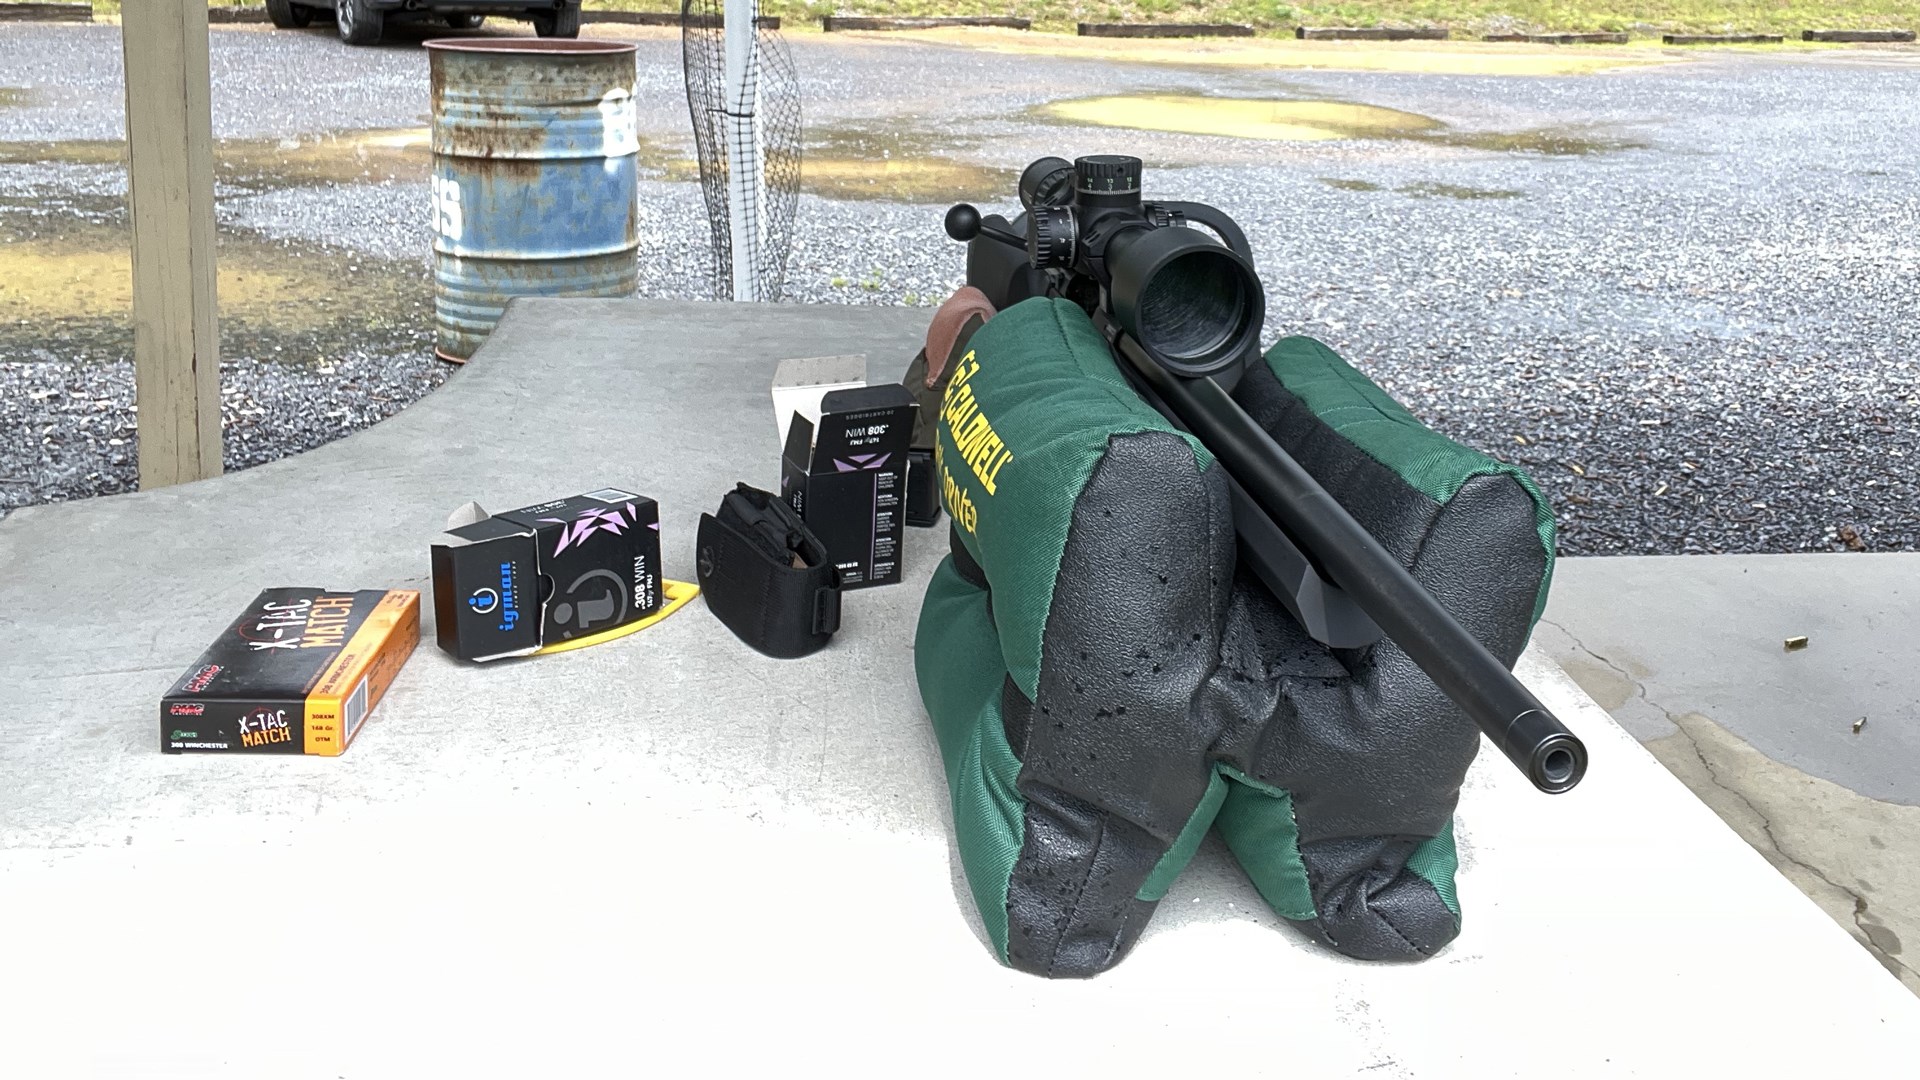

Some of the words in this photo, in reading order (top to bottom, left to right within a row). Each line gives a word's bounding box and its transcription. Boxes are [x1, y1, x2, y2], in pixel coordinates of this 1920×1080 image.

[845, 427, 866, 438] WIN
[867, 424, 889, 436] .308
[946, 383, 1011, 496] CALDWELL
[634, 555, 645, 583] WIN
[499, 562, 519, 632] igman
[634, 584, 646, 610] .308
[248, 598, 312, 652] X-TAC
[300, 596, 354, 649] MATCH
[238, 710, 288, 734] X-TAC
[241, 727, 291, 748] MATCH
